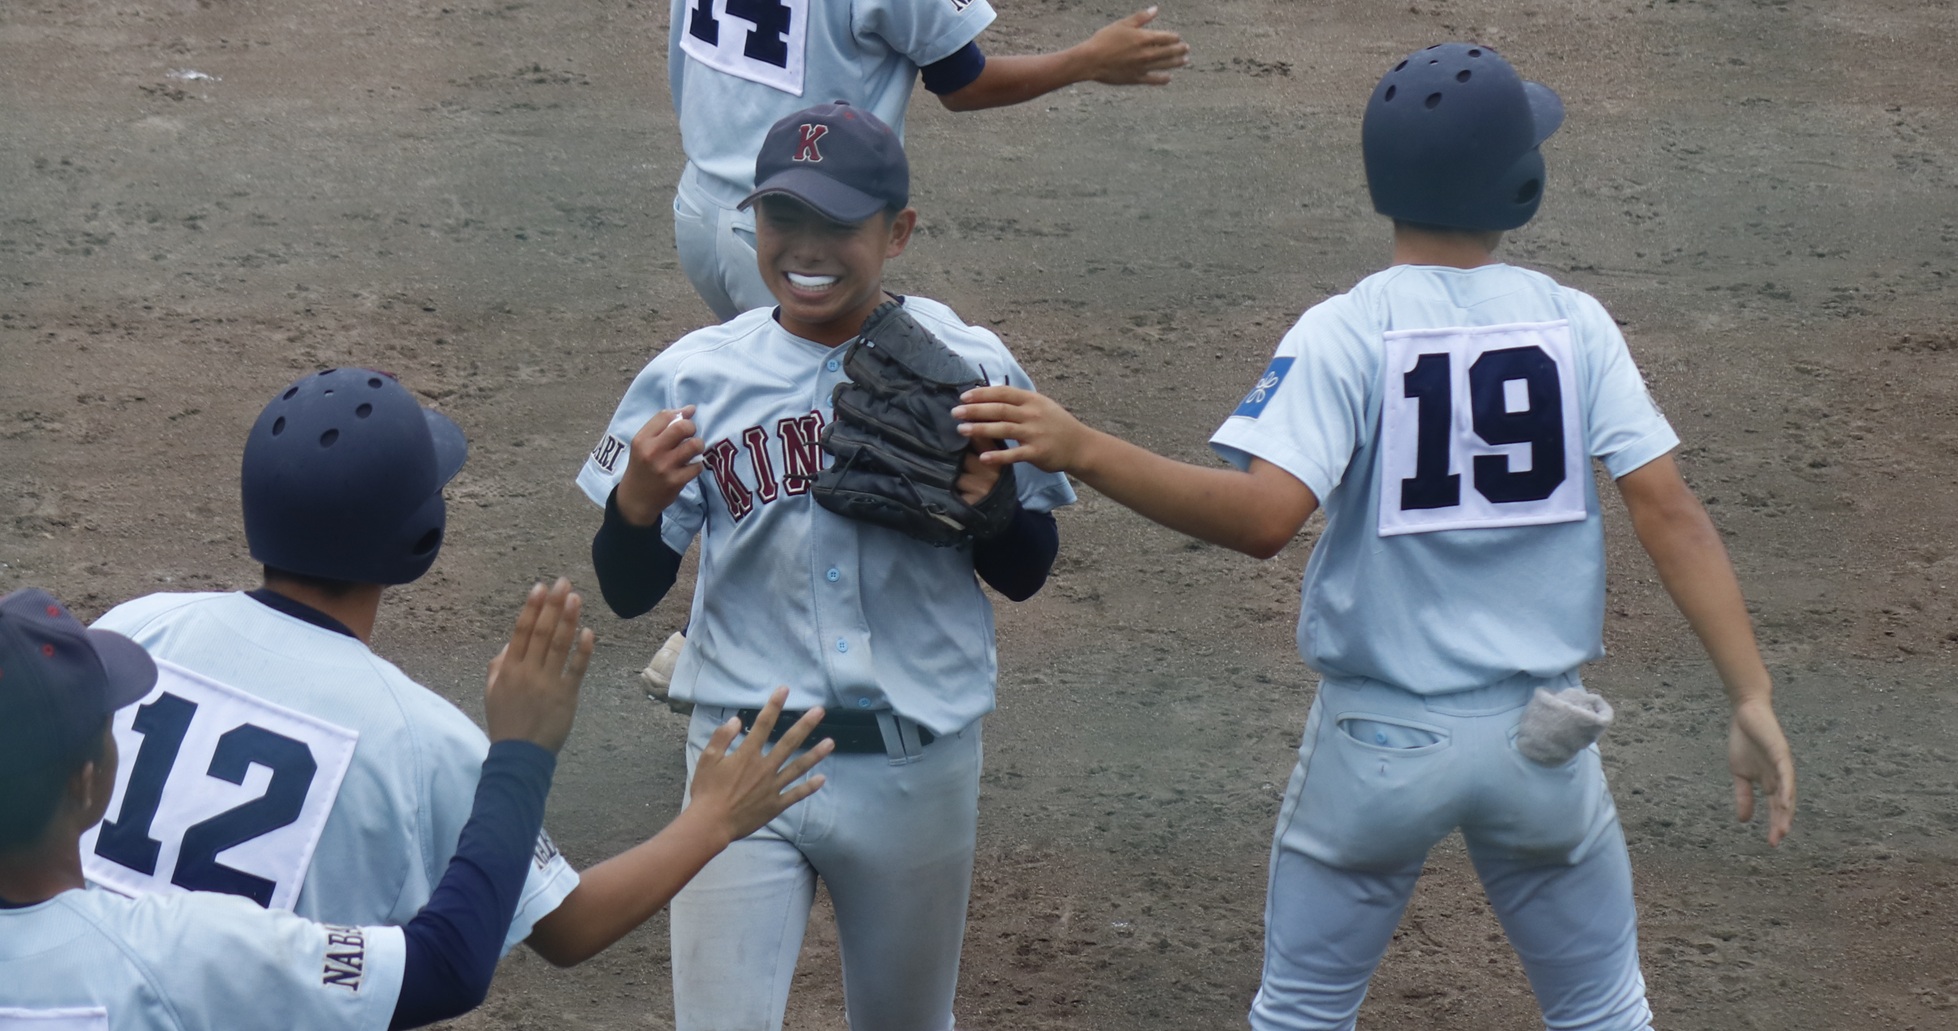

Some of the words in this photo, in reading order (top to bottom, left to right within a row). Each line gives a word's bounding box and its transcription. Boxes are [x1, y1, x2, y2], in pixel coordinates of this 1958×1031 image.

[792, 123, 829, 162] K
[702, 410, 838, 523] KIN
[1400, 345, 1566, 511] 19
[94, 691, 318, 909] 12
[323, 926, 364, 991] NAB
